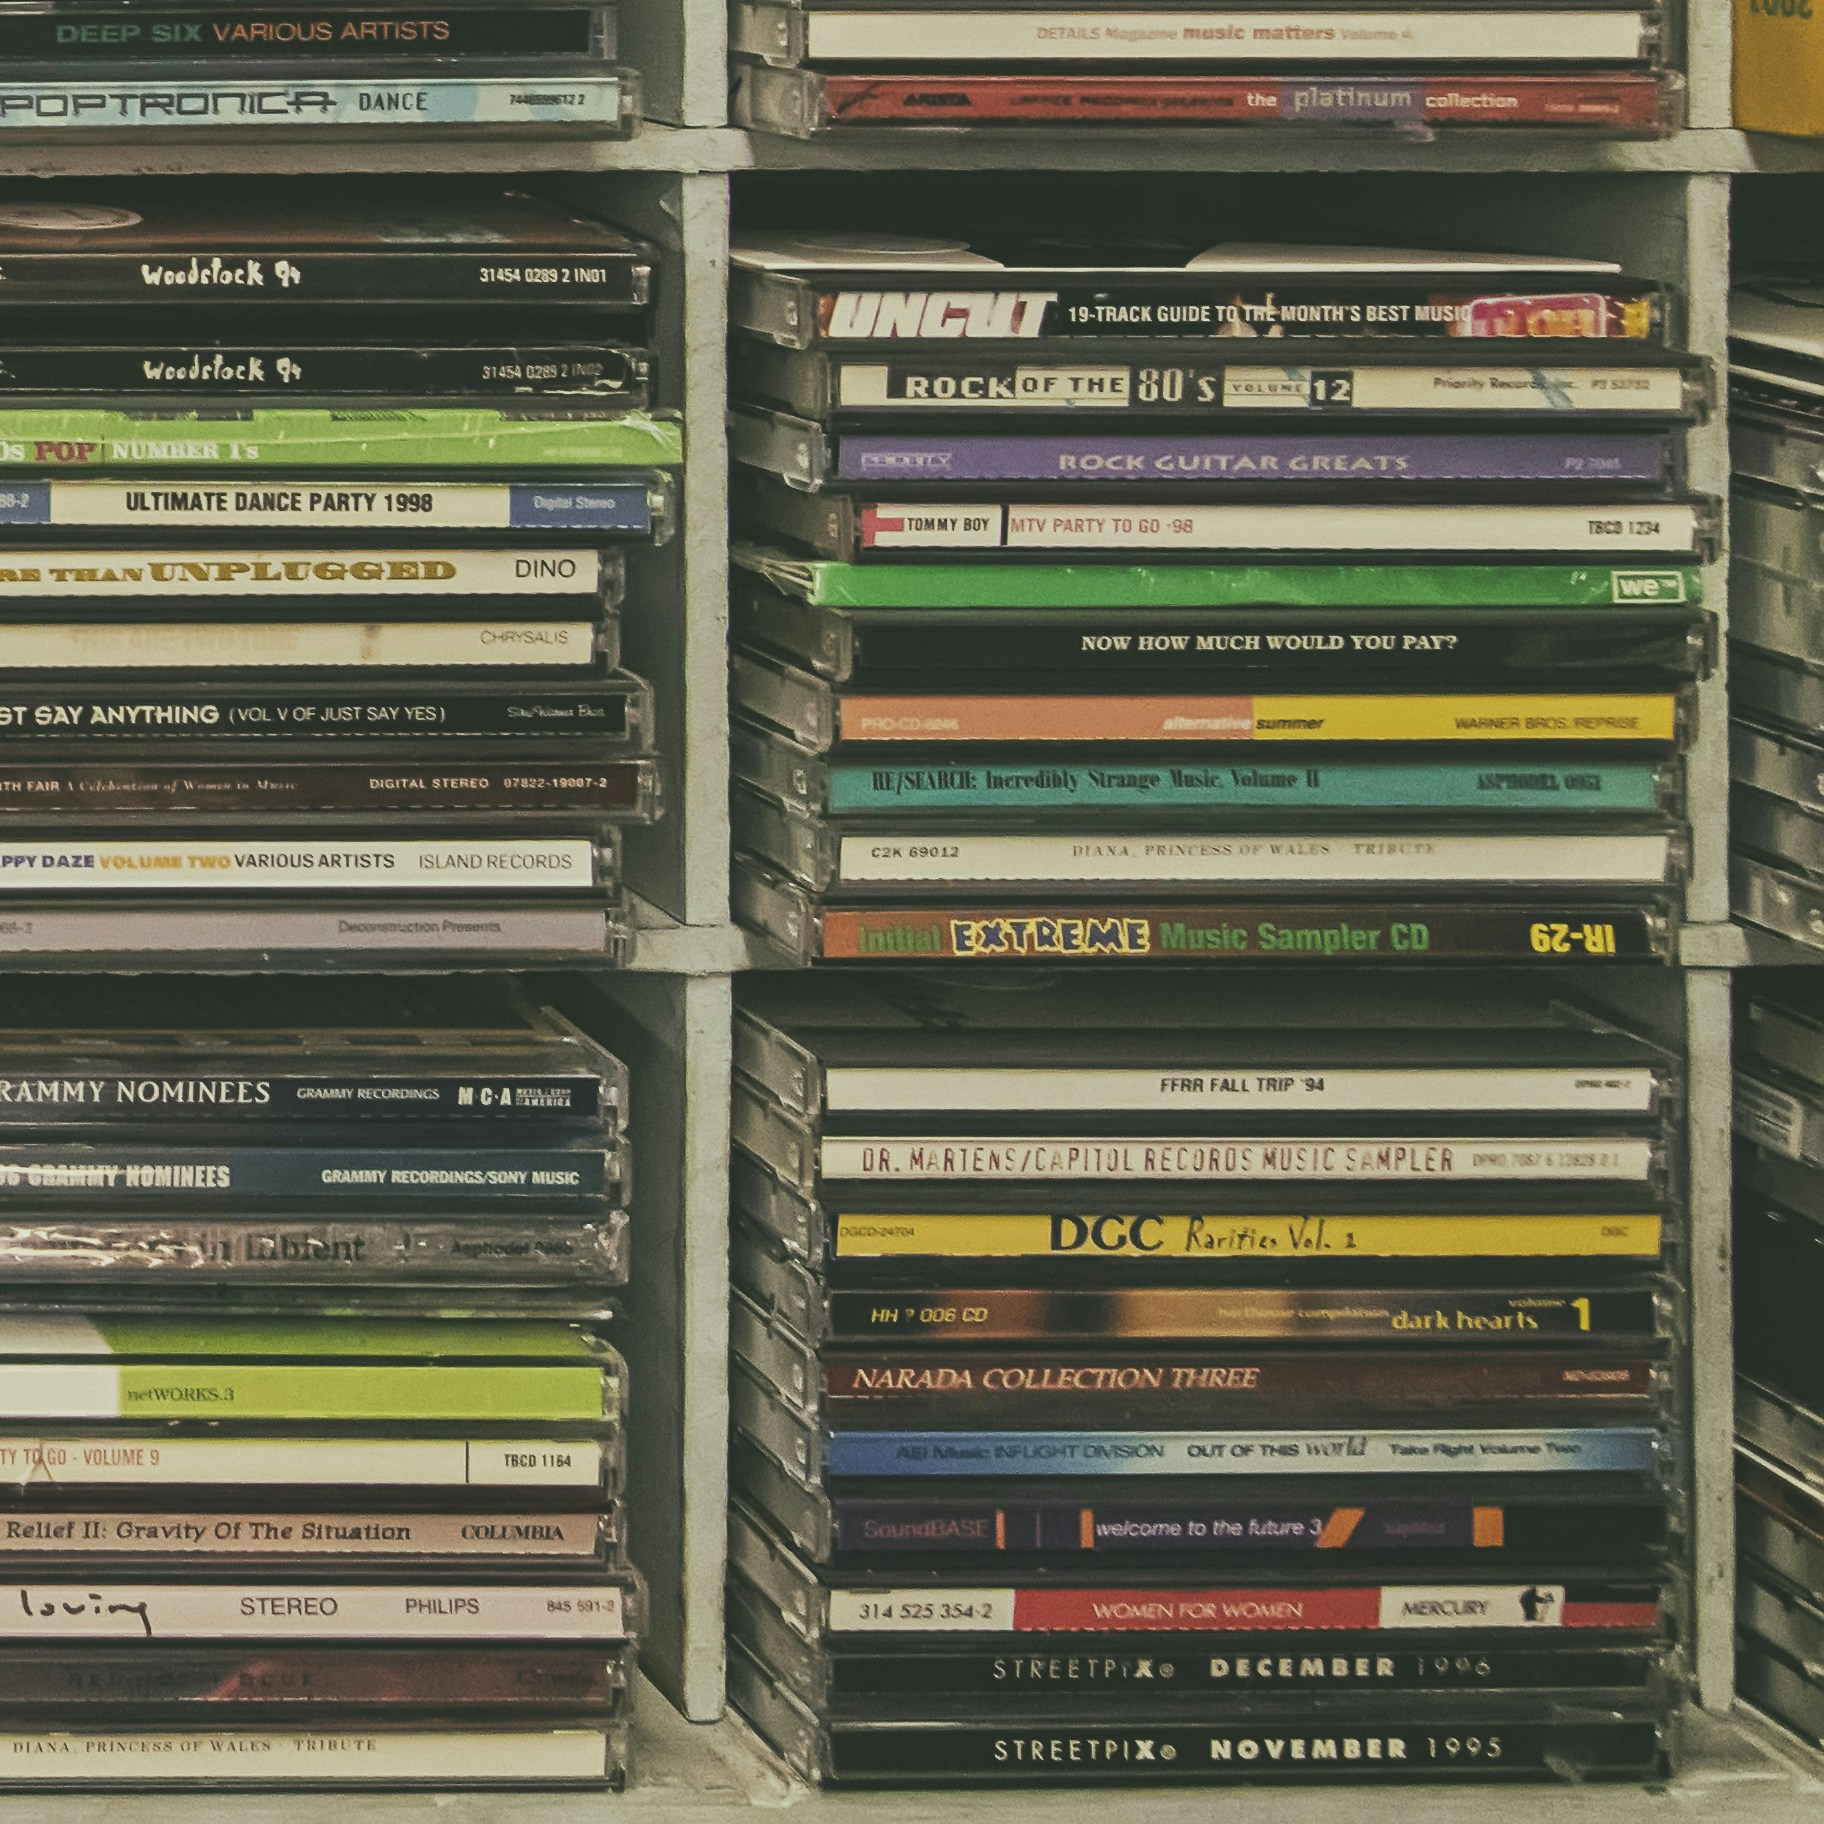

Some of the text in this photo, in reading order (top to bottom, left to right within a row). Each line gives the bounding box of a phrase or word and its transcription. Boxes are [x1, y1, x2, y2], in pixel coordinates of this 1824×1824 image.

[1058, 454, 1408, 472] ROCK GUITAR GREATS
[126, 491, 433, 513] ULTIMATE DANCE PARTY 1998
[1081, 634, 1458, 651] NOW HOW MUCH WOULD YOU PAY?
[852, 1367, 1261, 1389] NARADA COLLECTION THREE
[21, 1591, 154, 1636] loving
[240, 1596, 339, 1617] STEREO
[405, 1597, 480, 1616] PHILIPS
